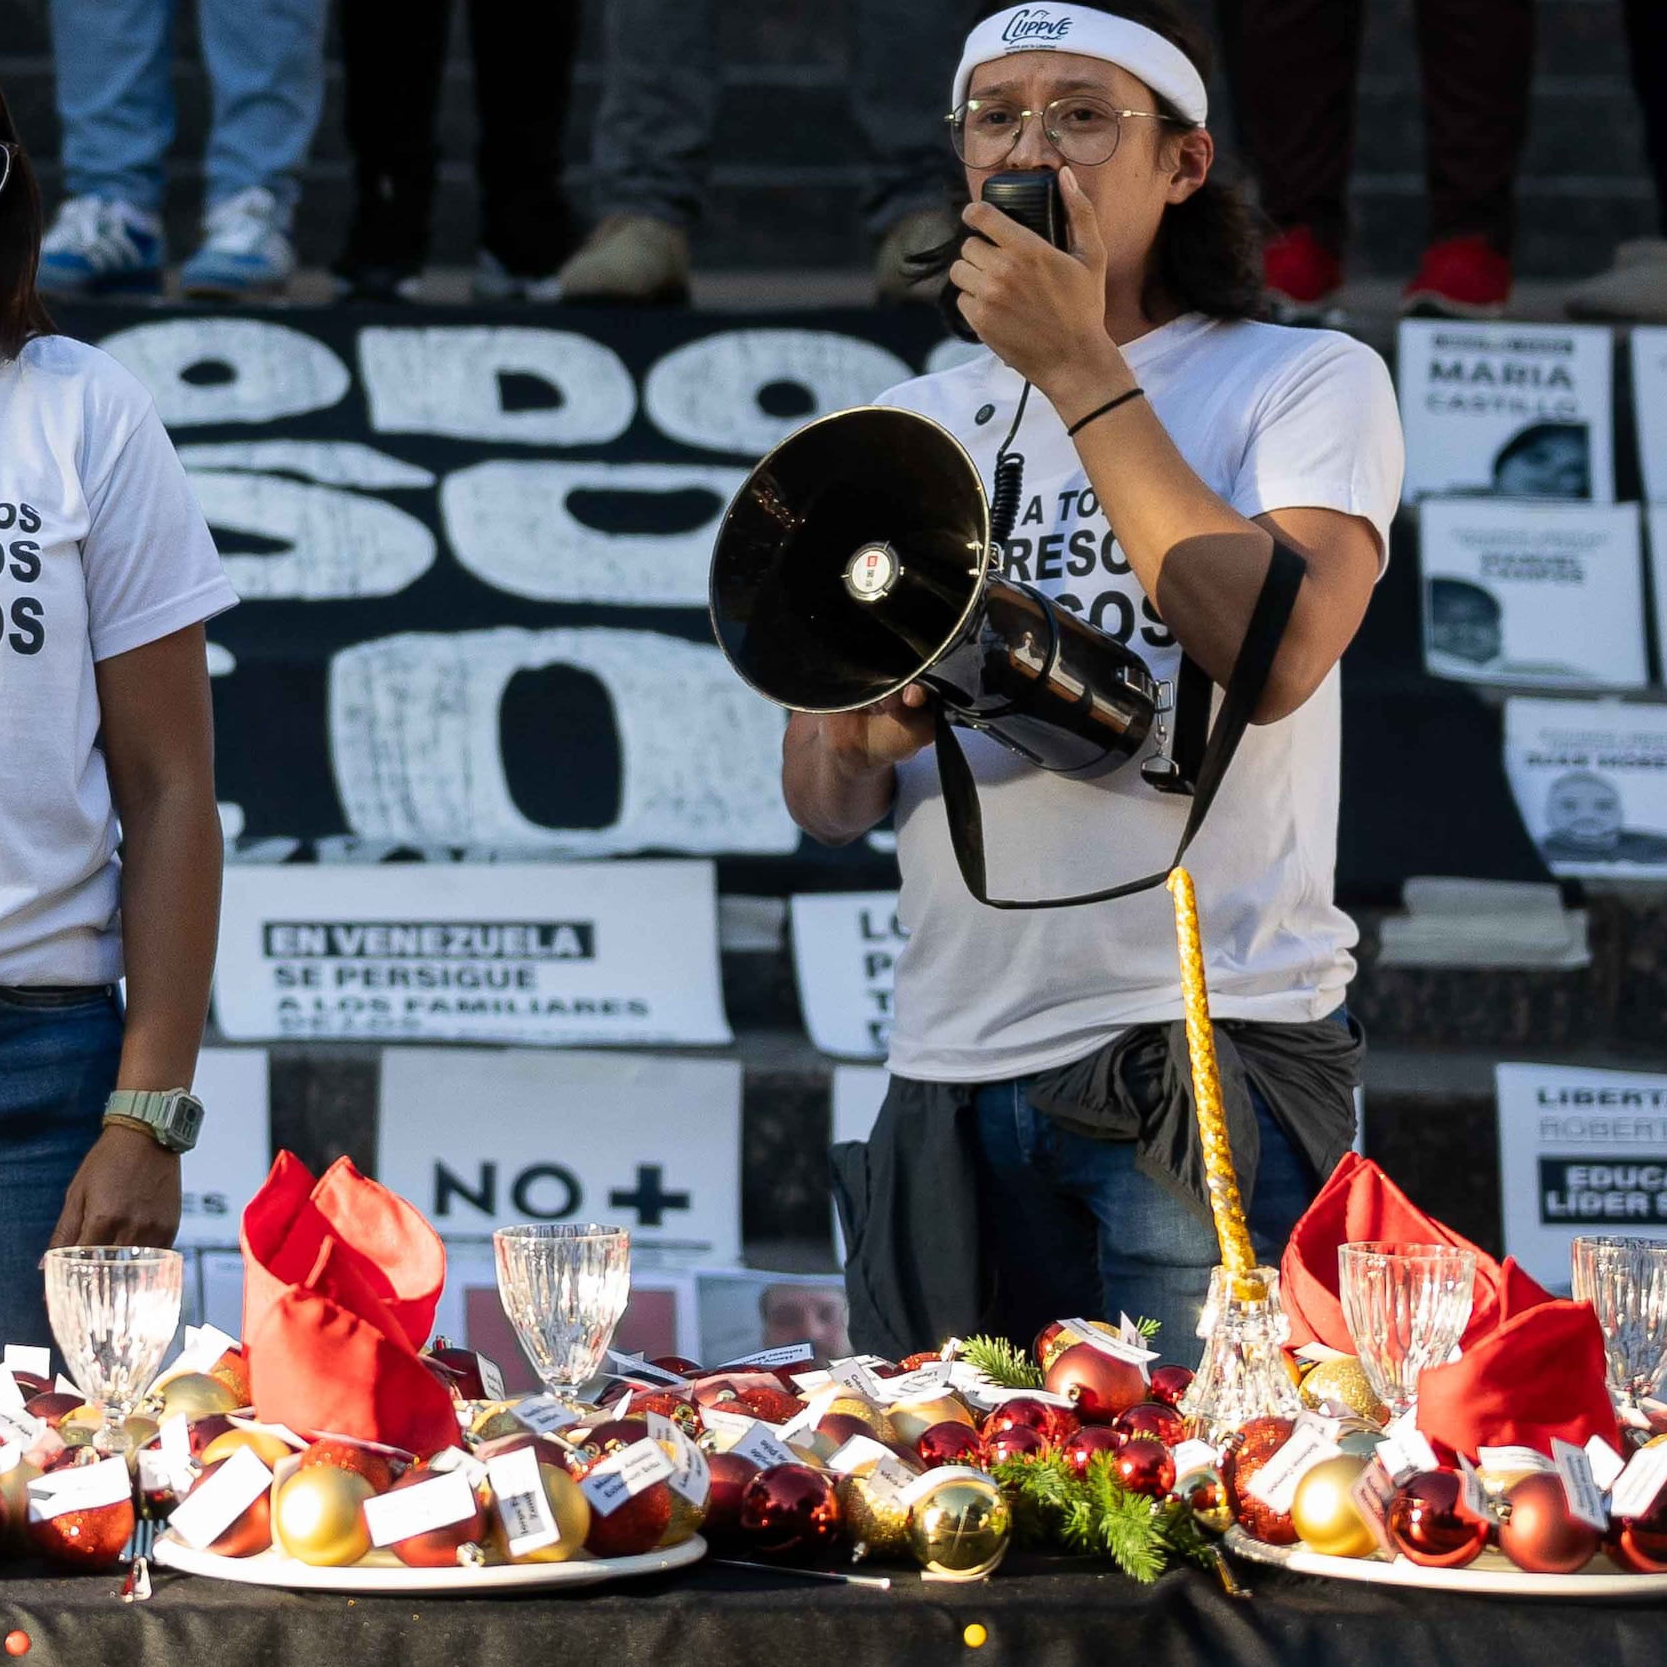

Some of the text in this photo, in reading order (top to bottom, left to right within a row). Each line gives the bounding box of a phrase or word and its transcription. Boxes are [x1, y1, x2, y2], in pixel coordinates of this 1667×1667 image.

[1020, 486, 1108, 526] A TO
[1003, 529, 1134, 583] RESO
[272, 925, 585, 958] EN VENEZUELA
[273, 965, 538, 992] SE PERSIGUE
[312, 997, 391, 1015] LOS
[1536, 1086, 1667, 1106] LIBERT
[433, 1159, 585, 1219] NO
[1567, 1165, 1667, 1192] EDUC
